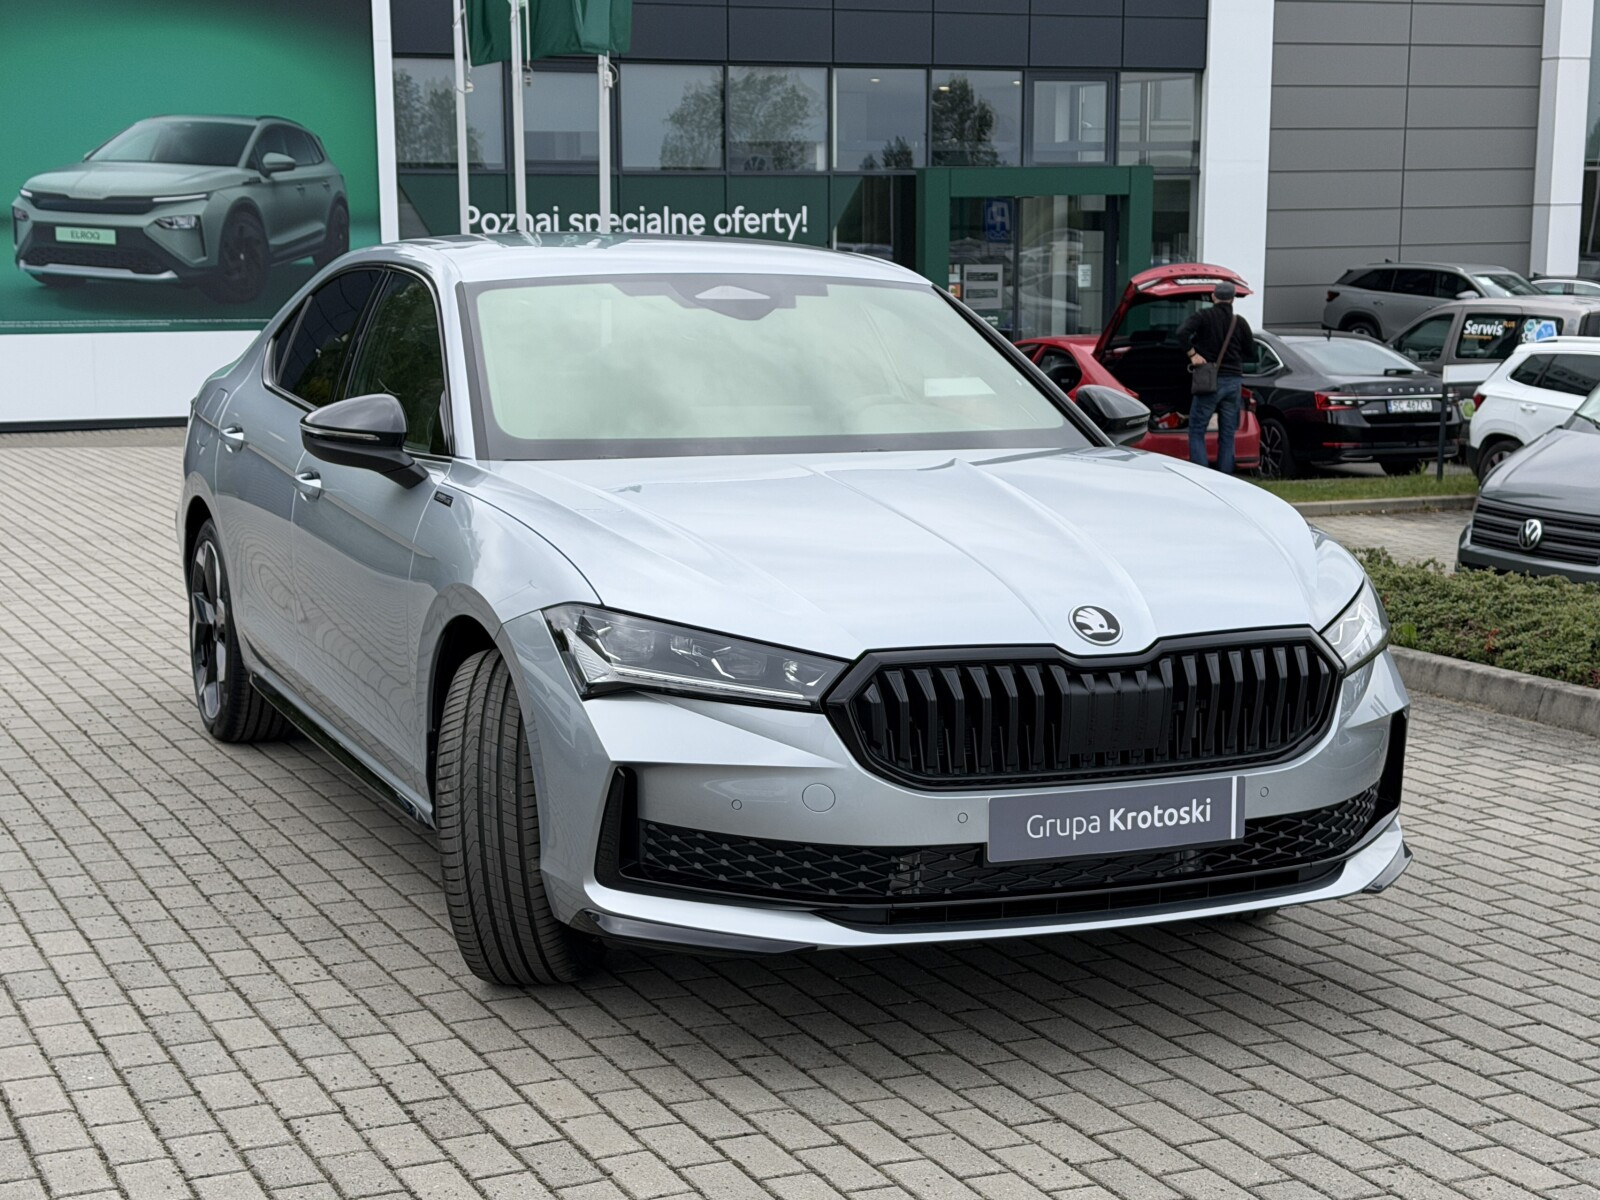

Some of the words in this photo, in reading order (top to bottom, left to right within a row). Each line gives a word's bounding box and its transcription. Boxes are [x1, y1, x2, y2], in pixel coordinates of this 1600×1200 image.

[713, 205, 808, 241] oferty!
[1463, 320, 1503, 336] Serwis
[1026, 814, 1100, 841] Grupa
[1109, 798, 1211, 832] Krotoski
